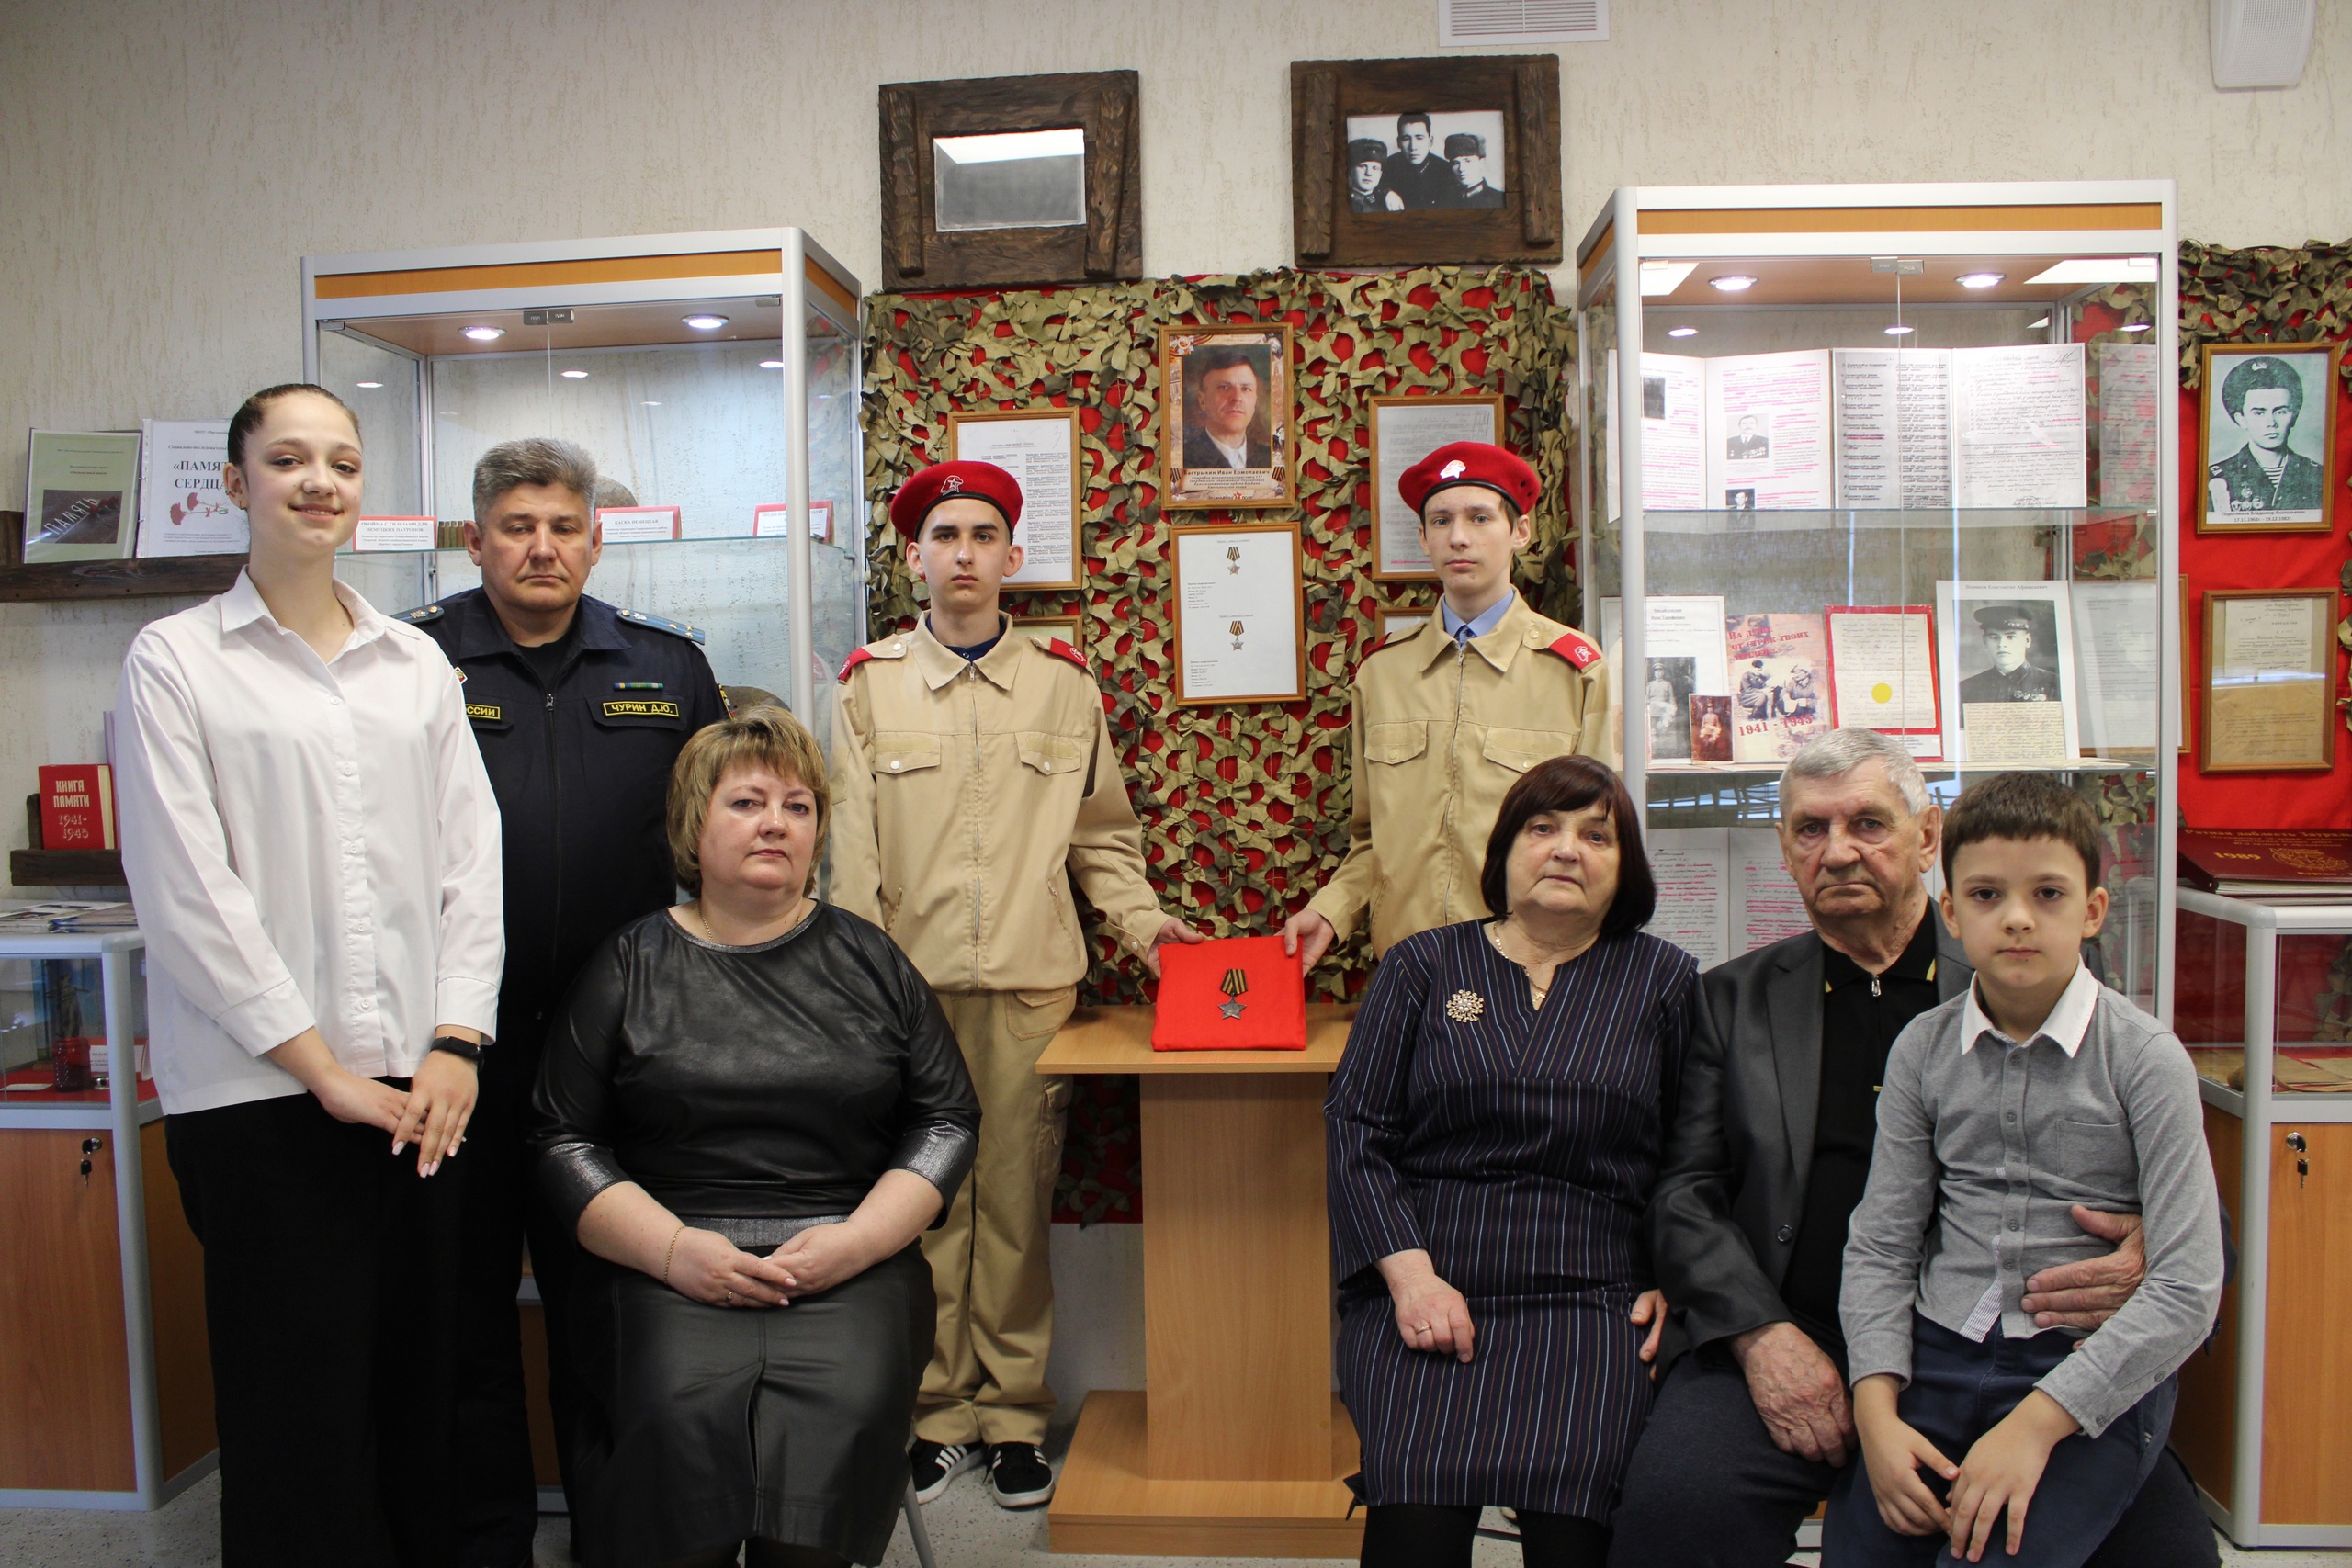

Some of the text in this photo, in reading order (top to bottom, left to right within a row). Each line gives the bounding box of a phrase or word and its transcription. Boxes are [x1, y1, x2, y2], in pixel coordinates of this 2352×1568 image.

[466, 705, 496, 716] ССИИ
[611, 704, 673, 714] ЧУРИН Д.Ю.
[1738, 721, 1770, 737] 1941
[1782, 713, 1814, 728] 1945
[56, 780, 85, 793] КНИГА
[53, 795, 90, 808] ПАМЯТИ
[59, 814, 87, 828] 1941-
[62, 828, 89, 841] 1945
